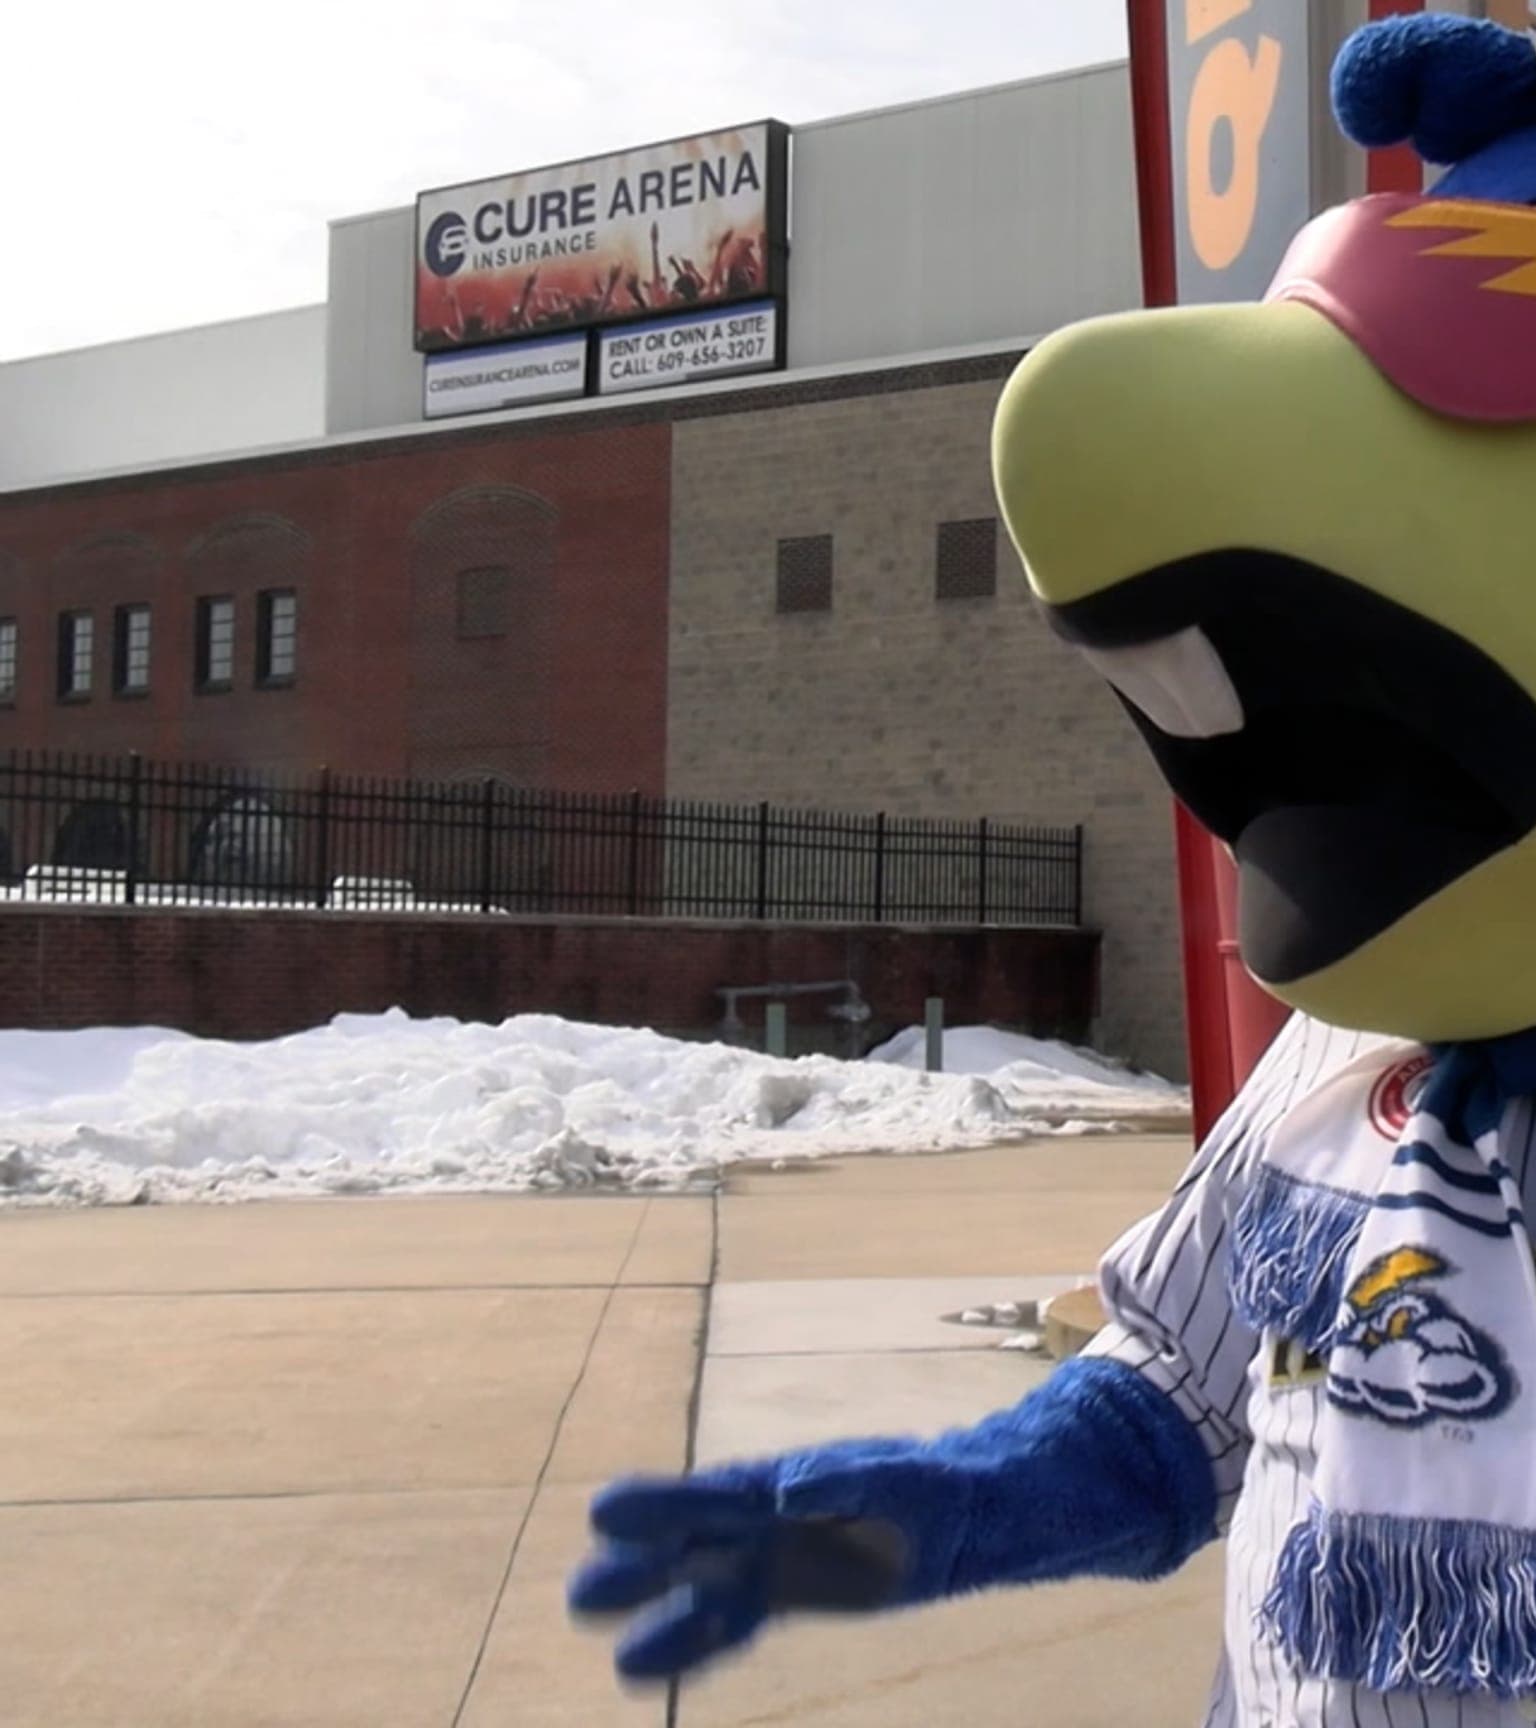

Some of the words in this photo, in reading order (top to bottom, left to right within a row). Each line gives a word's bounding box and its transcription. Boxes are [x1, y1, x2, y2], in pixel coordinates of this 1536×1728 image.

[473, 183, 597, 245] CURE
[607, 152, 761, 220] ARENA
[472, 230, 597, 271] INSURANCE
[608, 336, 641, 358] RENT
[645, 332, 666, 352] OR
[670, 326, 707, 347] OWN
[711, 323, 723, 341] A
[609, 355, 653, 380] CALL:
[656, 337, 766, 373] 609-656-3207
[428, 357, 581, 394] CUREINSURANCEARENA.COM
